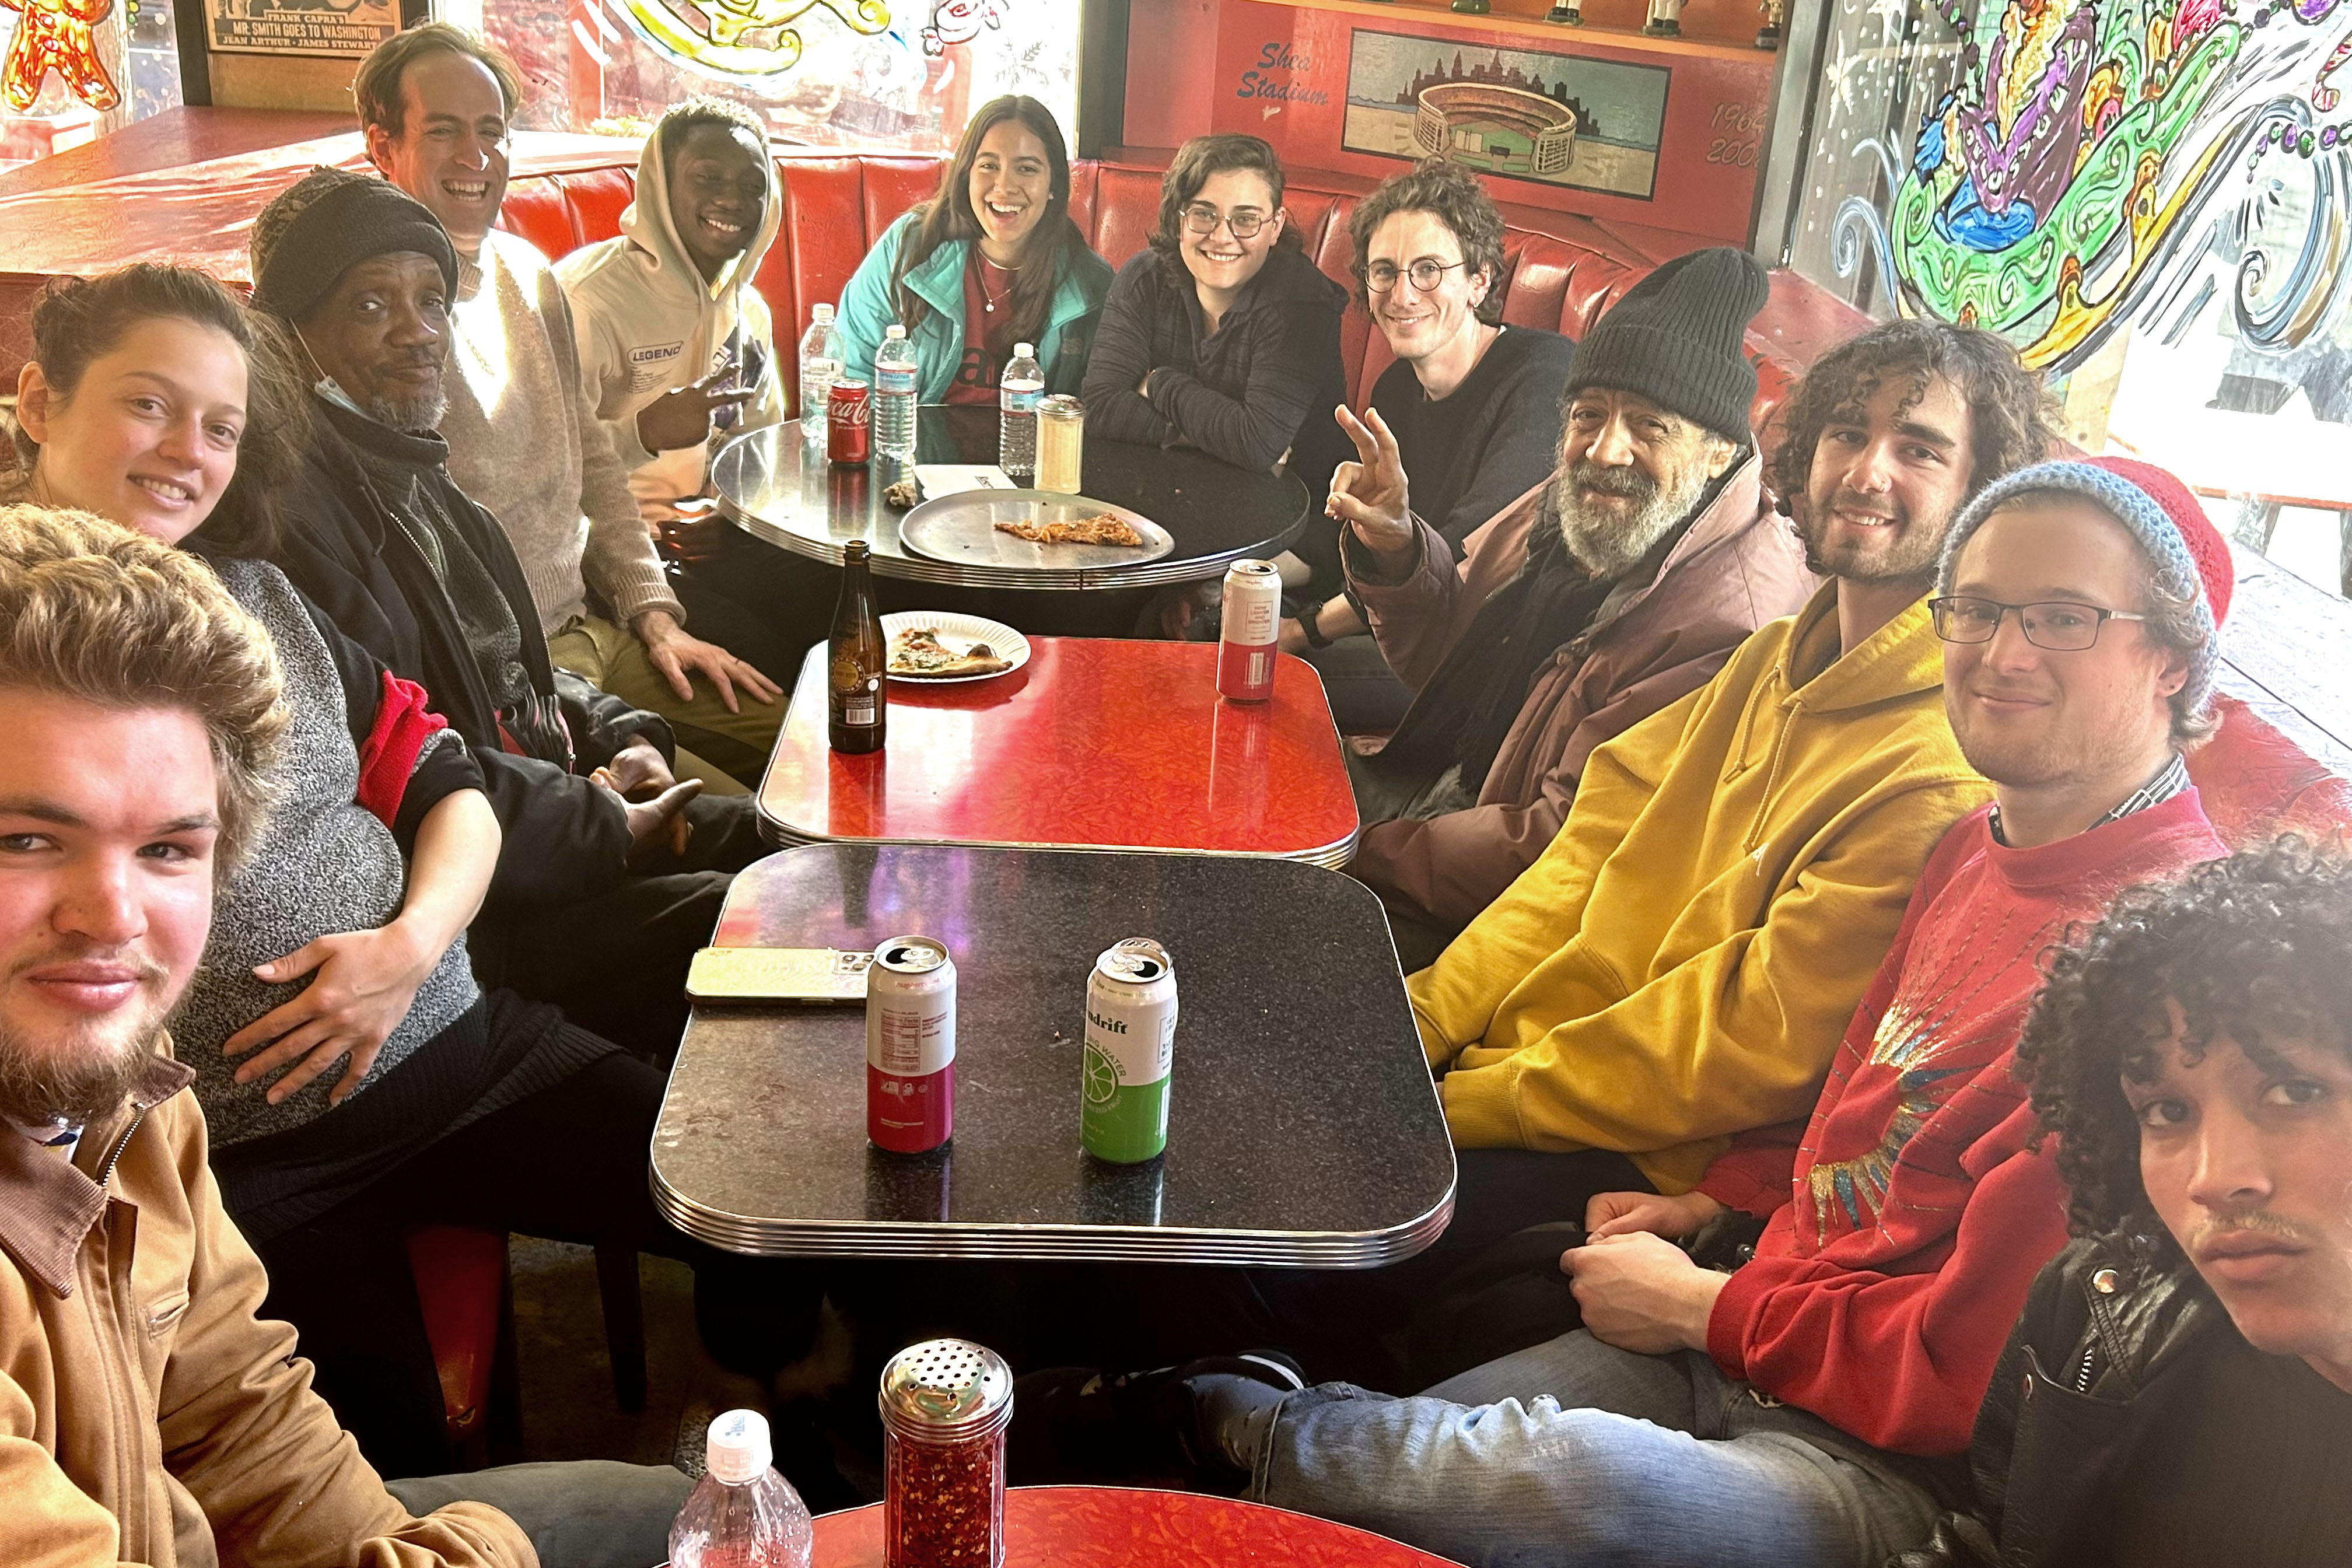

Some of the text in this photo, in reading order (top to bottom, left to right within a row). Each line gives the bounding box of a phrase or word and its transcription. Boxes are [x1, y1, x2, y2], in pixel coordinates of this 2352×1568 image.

[233, 22, 381, 40] MR. SMITH GOES TO WASHINGTON
[268, 13, 345, 24] FRANK CAPRA'S
[223, 36, 378, 50] JEAN ARTHUR JAMES STEWART
[1257, 43, 1311, 71] Shea
[1237, 71, 1329, 106] Stadium
[1710, 103, 1766, 134] 1964
[1102, 1046, 1126, 1076] WATER
